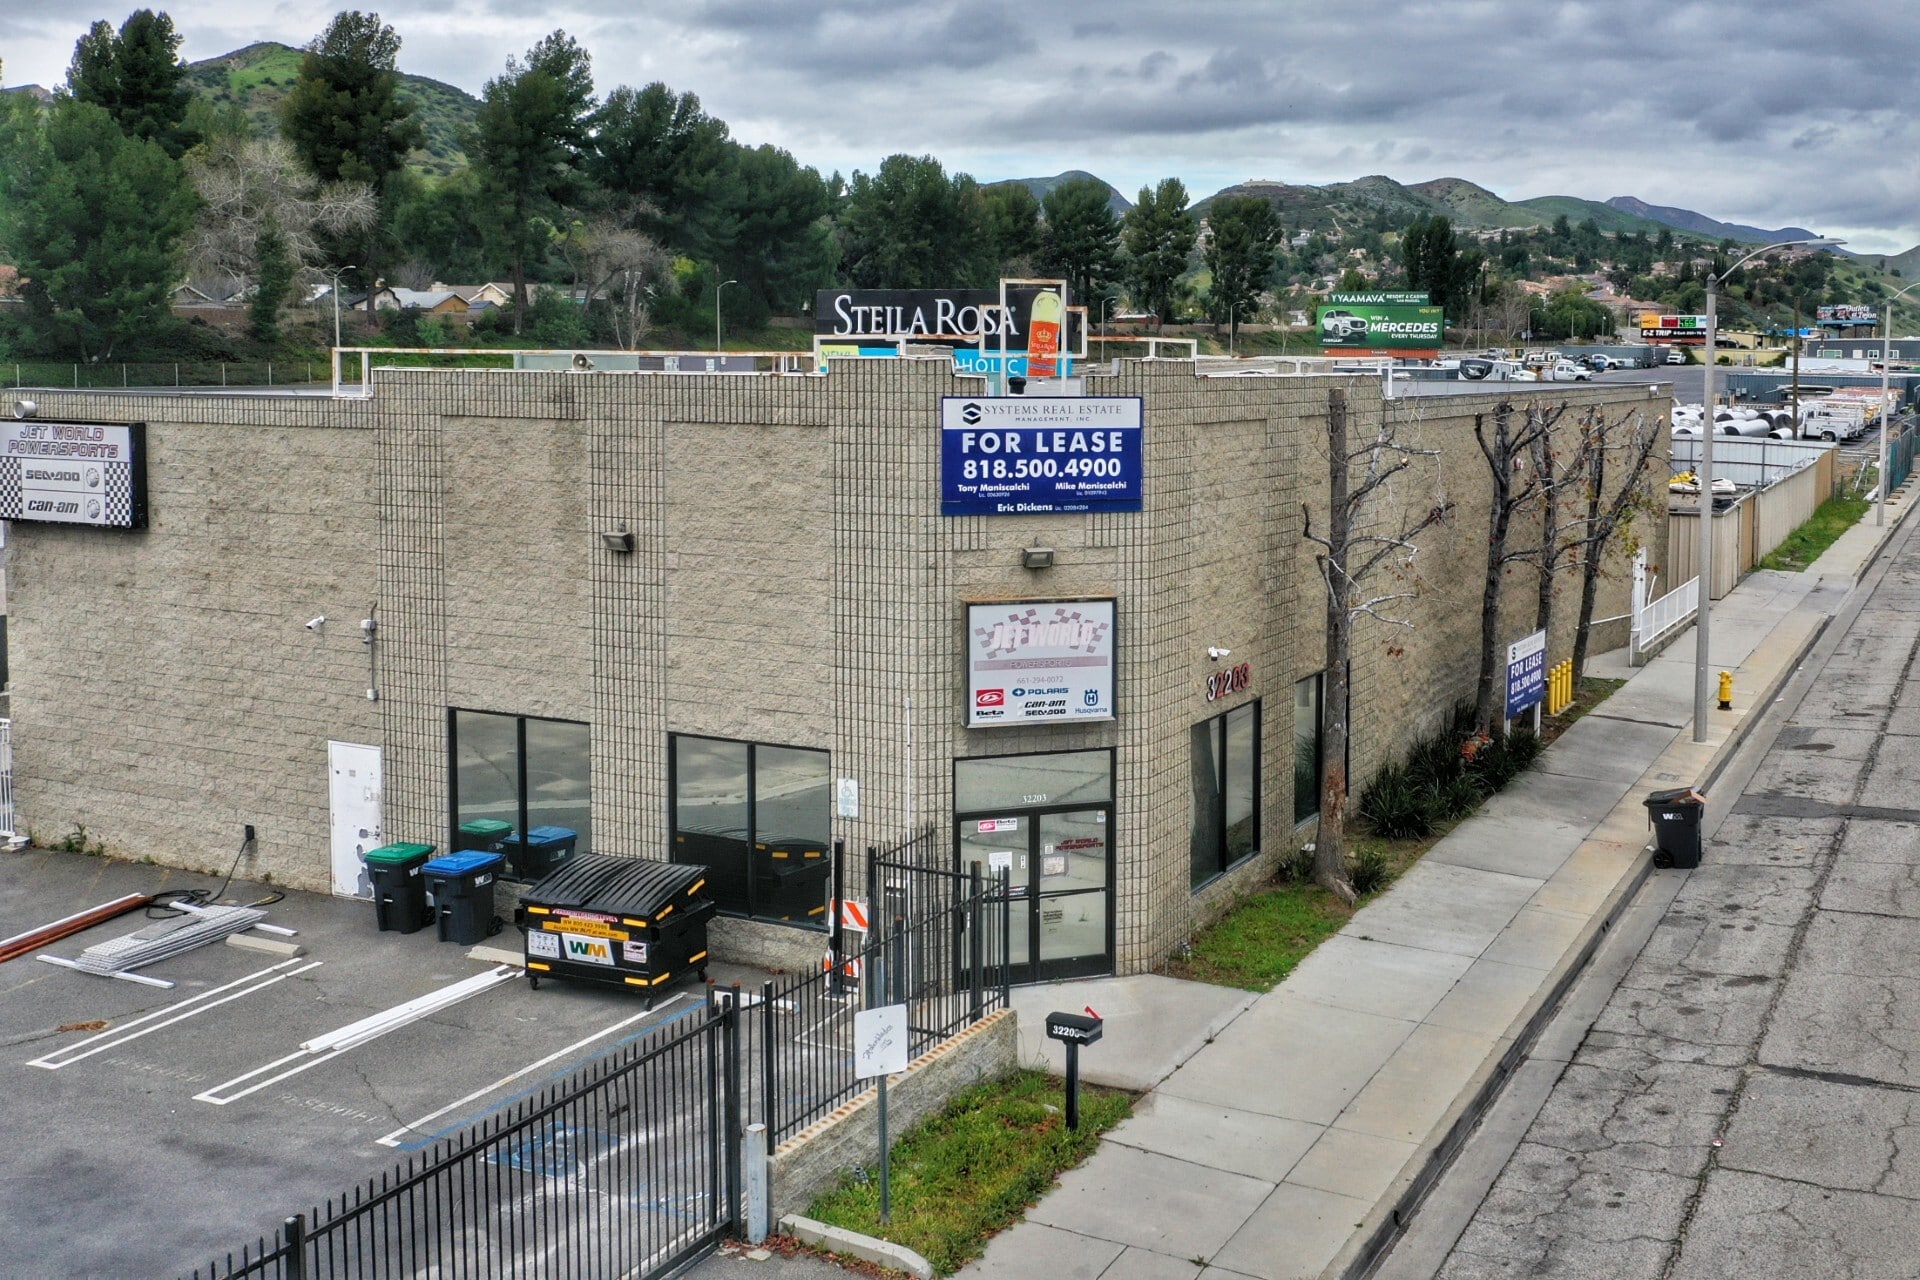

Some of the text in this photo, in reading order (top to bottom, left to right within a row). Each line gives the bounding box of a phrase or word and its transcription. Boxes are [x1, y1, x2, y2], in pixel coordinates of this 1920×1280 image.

[1370, 322, 1438, 332] MERCEDES
[984, 405, 1122, 415] SYSTEMS REAL ESTATE
[20, 425, 104, 441] JET WORLD
[8, 439, 119, 458] POWERSPORTS
[962, 431, 1123, 453] FOR LEASE
[963, 458, 1121, 479] 818.500.4900
[957, 482, 1030, 493] Tony Maniscalchi
[1055, 482, 1076, 490] Mike
[28, 500, 79, 513] can-am
[997, 503, 1015, 512] Eric
[1016, 502, 1053, 511] Dickens
[989, 624, 1024, 648] JET
[1010, 660, 1072, 668] POWERSPORTS
[1511, 652, 1542, 679] FOR LEASE
[1206, 663, 1250, 702] 32203
[1510, 669, 1541, 695] 818.500.4900
[1021, 793, 1047, 803] 32203
[569, 940, 607, 957] WM
